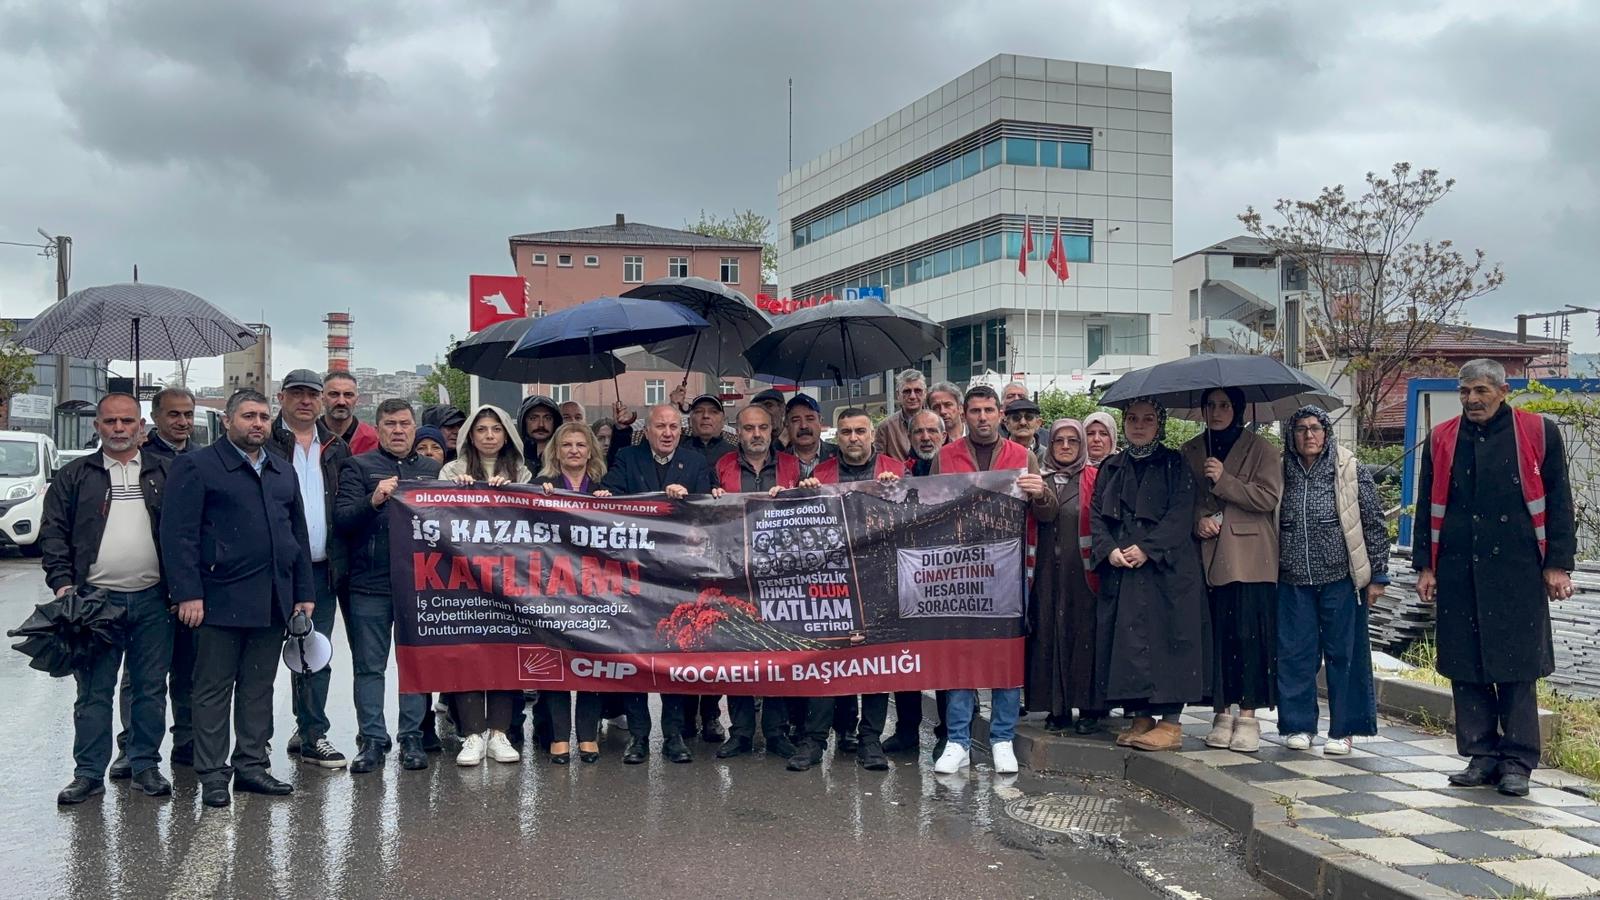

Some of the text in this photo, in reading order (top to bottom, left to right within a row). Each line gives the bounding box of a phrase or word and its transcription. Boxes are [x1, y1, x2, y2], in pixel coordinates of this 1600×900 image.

[415, 492, 658, 513] DİLOVASINDA YANAN FABRİKAYI UNUTMADIK
[764, 504, 826, 518] HERKES GÖRDÜ
[411, 514, 656, 549] İŞ KAZASI DEĞİL
[756, 516, 838, 529] KİMSE DOKUNMADI!
[922, 548, 985, 566] DİLOVASI
[413, 551, 641, 597] KATLİAM!
[758, 571, 847, 587] DENETİMSİZLİK
[914, 562, 995, 584] CİNAYETİNİN
[760, 585, 806, 599] İHMAL
[925, 581, 985, 598] HESABINI
[431, 595, 511, 611] Cinayetlerinin
[514, 603, 566, 614] hesabını
[569, 602, 632, 616] soracağız.
[760, 598, 852, 621] KATLİAM
[918, 596, 993, 614] SORACAĞIZ!
[417, 609, 611, 632] Kaybettiklerimizi unutmayacağız,
[804, 619, 854, 632] GETİRDİ
[570, 657, 637, 679] CHP
[669, 650, 921, 684] KOCAELİ İL BAŞKANLIĞI
